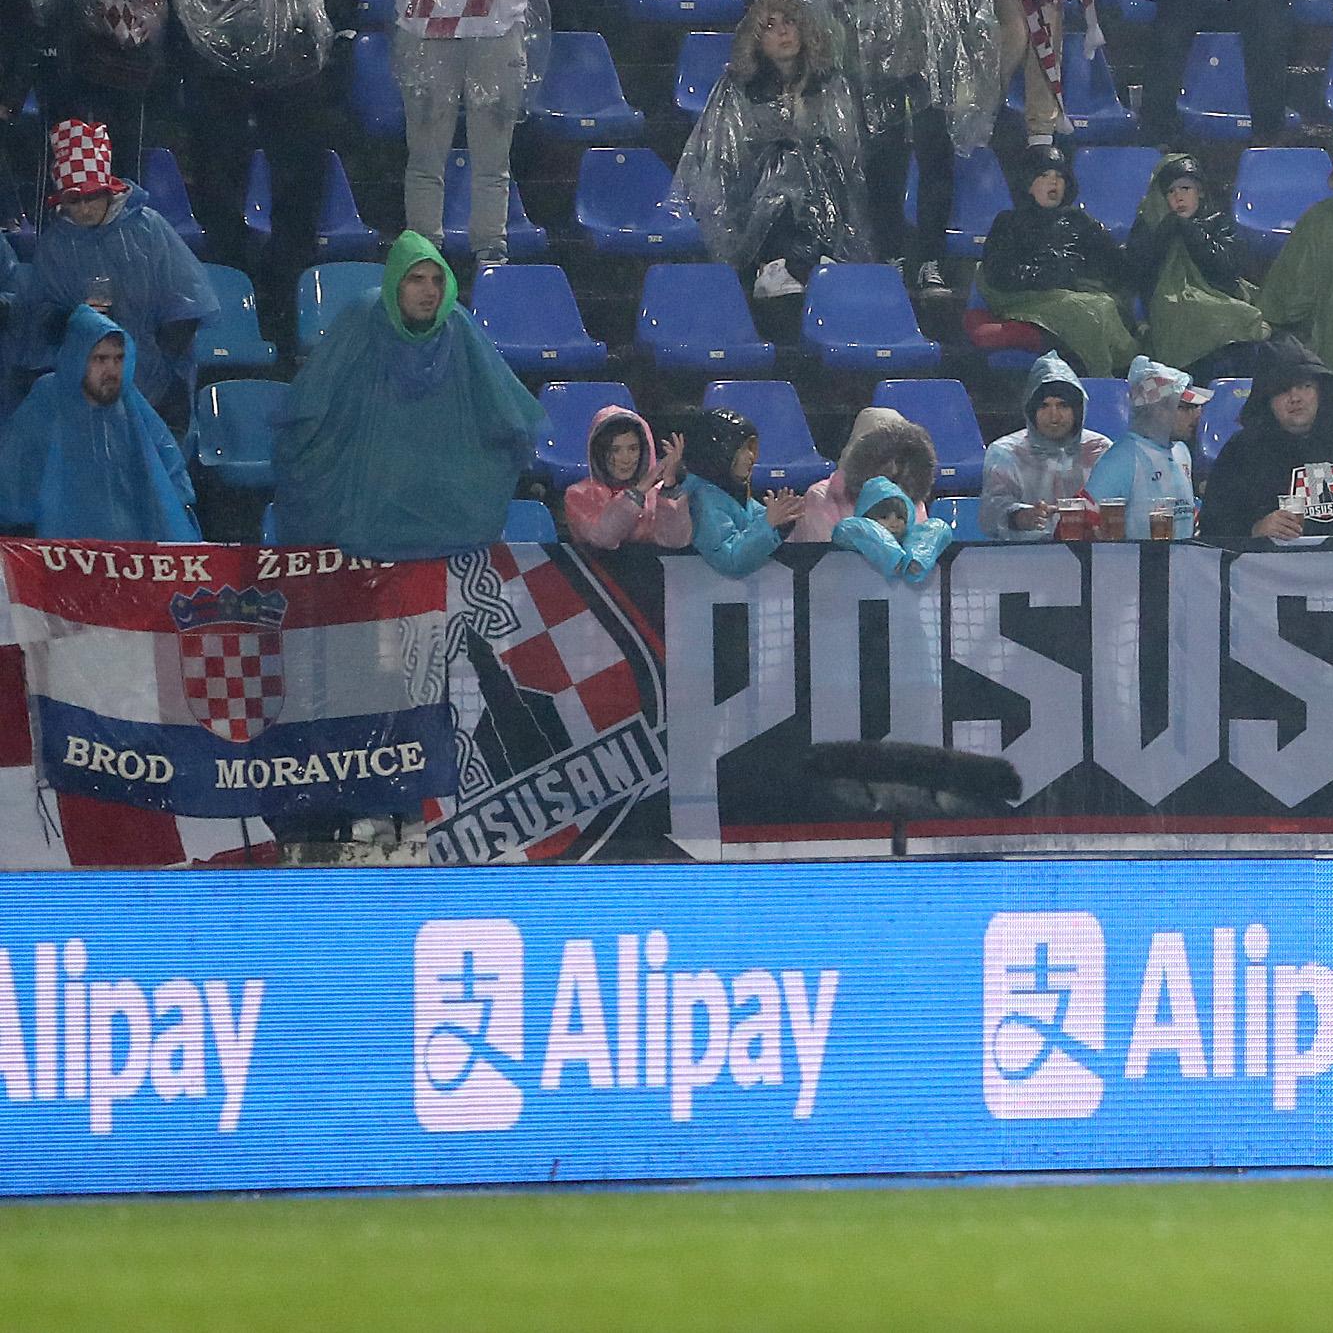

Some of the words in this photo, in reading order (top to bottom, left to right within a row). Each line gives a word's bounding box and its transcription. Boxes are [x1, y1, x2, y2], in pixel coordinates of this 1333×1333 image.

[37, 545, 213, 582] UVIJEK
[256, 547, 396, 581] ŽED
[62, 735, 175, 785] BROD
[214, 740, 427, 791] MORAVICE
[539, 929, 840, 1123] Alipay
